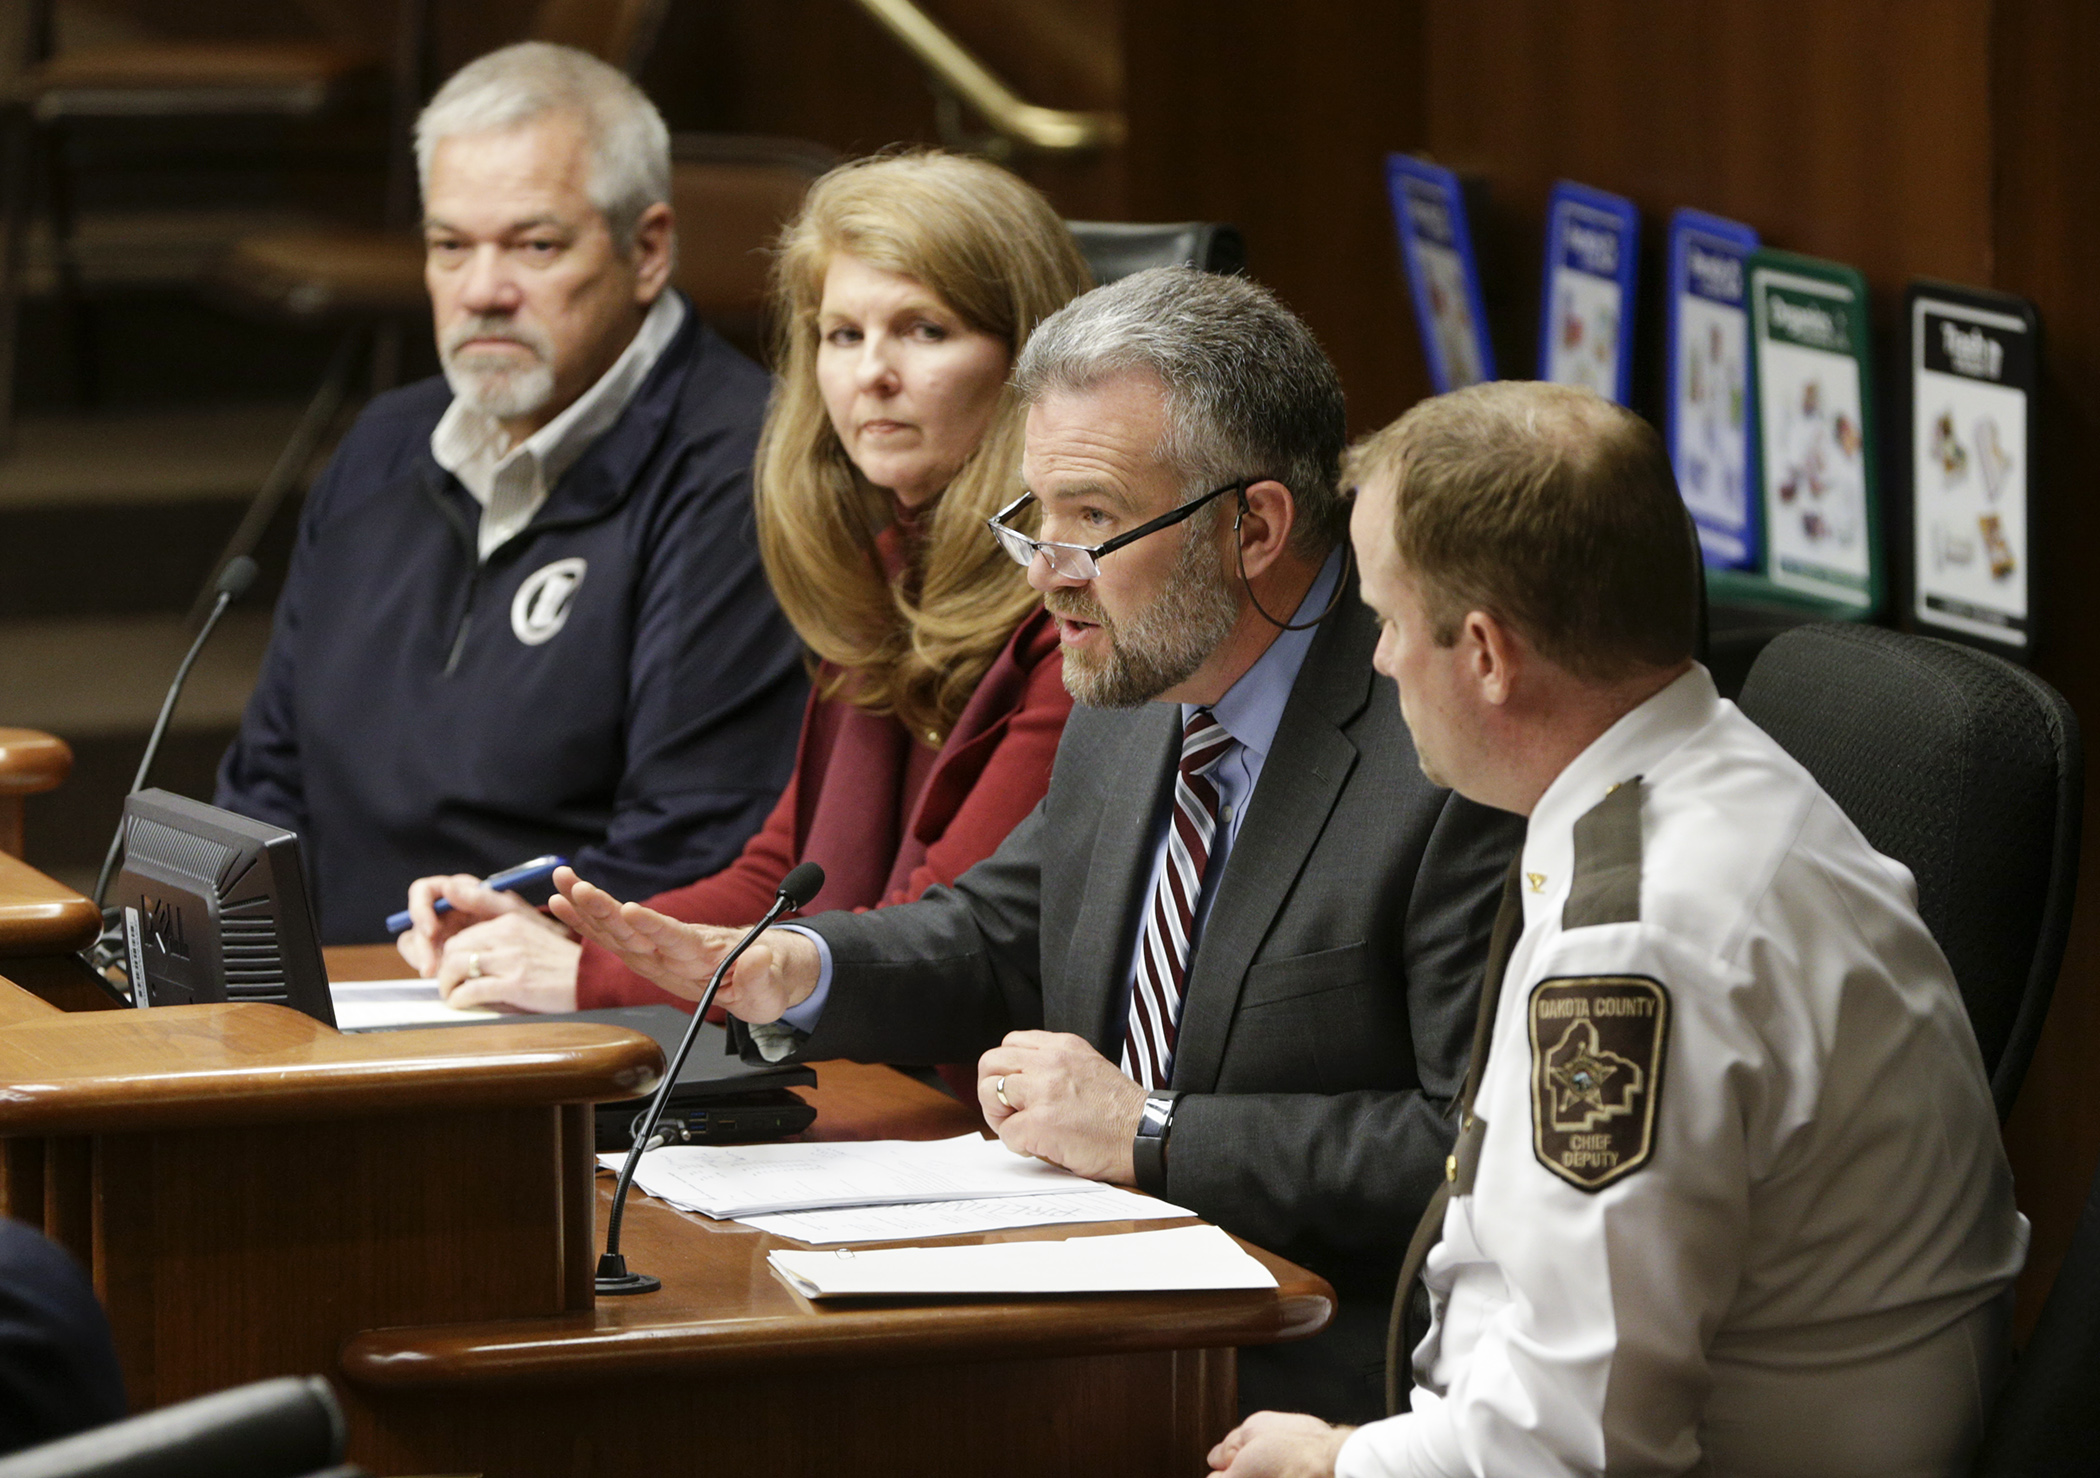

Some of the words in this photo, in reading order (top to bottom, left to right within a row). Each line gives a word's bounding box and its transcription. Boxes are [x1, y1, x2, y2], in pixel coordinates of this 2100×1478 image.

[1538, 997, 1590, 1019] DAKOTA
[1593, 996, 1657, 1018] COUNTY
[1569, 1133, 1612, 1150] CHIEF
[1561, 1150, 1620, 1167] DEPUTY
